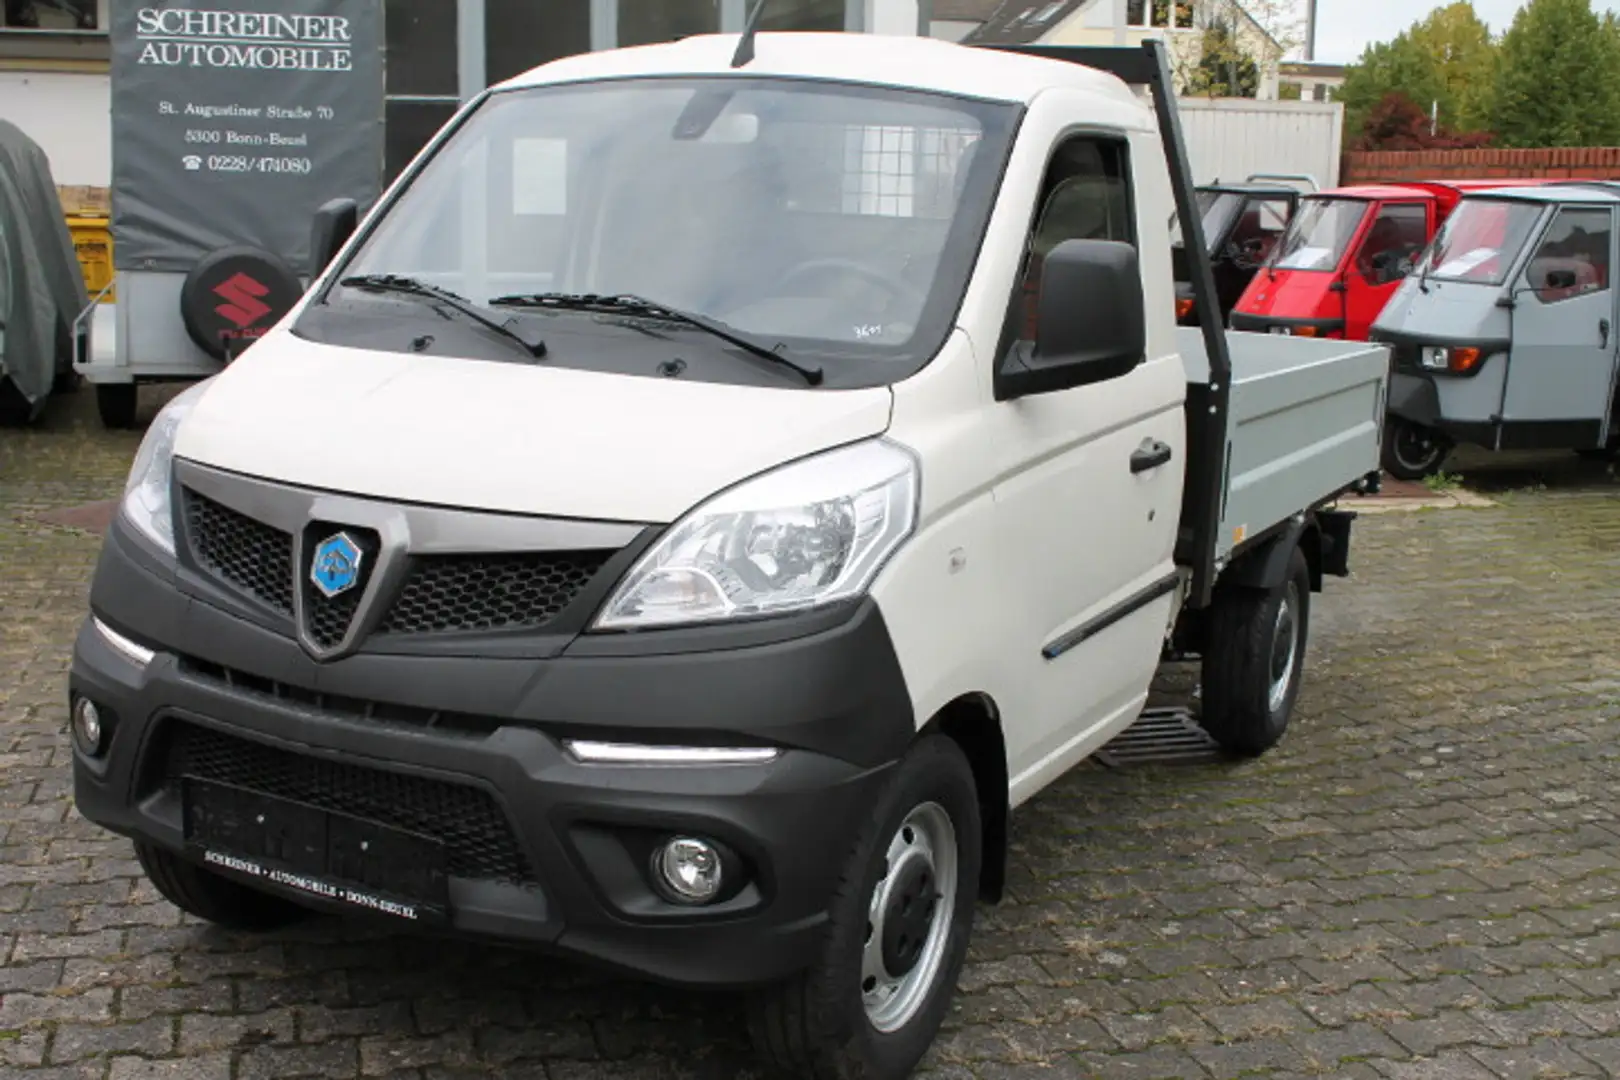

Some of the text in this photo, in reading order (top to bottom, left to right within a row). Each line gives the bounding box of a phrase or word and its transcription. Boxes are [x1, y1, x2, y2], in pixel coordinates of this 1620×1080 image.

[136, 7, 351, 41] SCHREINER
[137, 42, 352, 71] AUTOMOBILE
[158, 101, 179, 115] St.
[184, 103, 260, 119] Augustiner
[317, 106, 334, 119] 70
[184, 130, 221, 144] 5300
